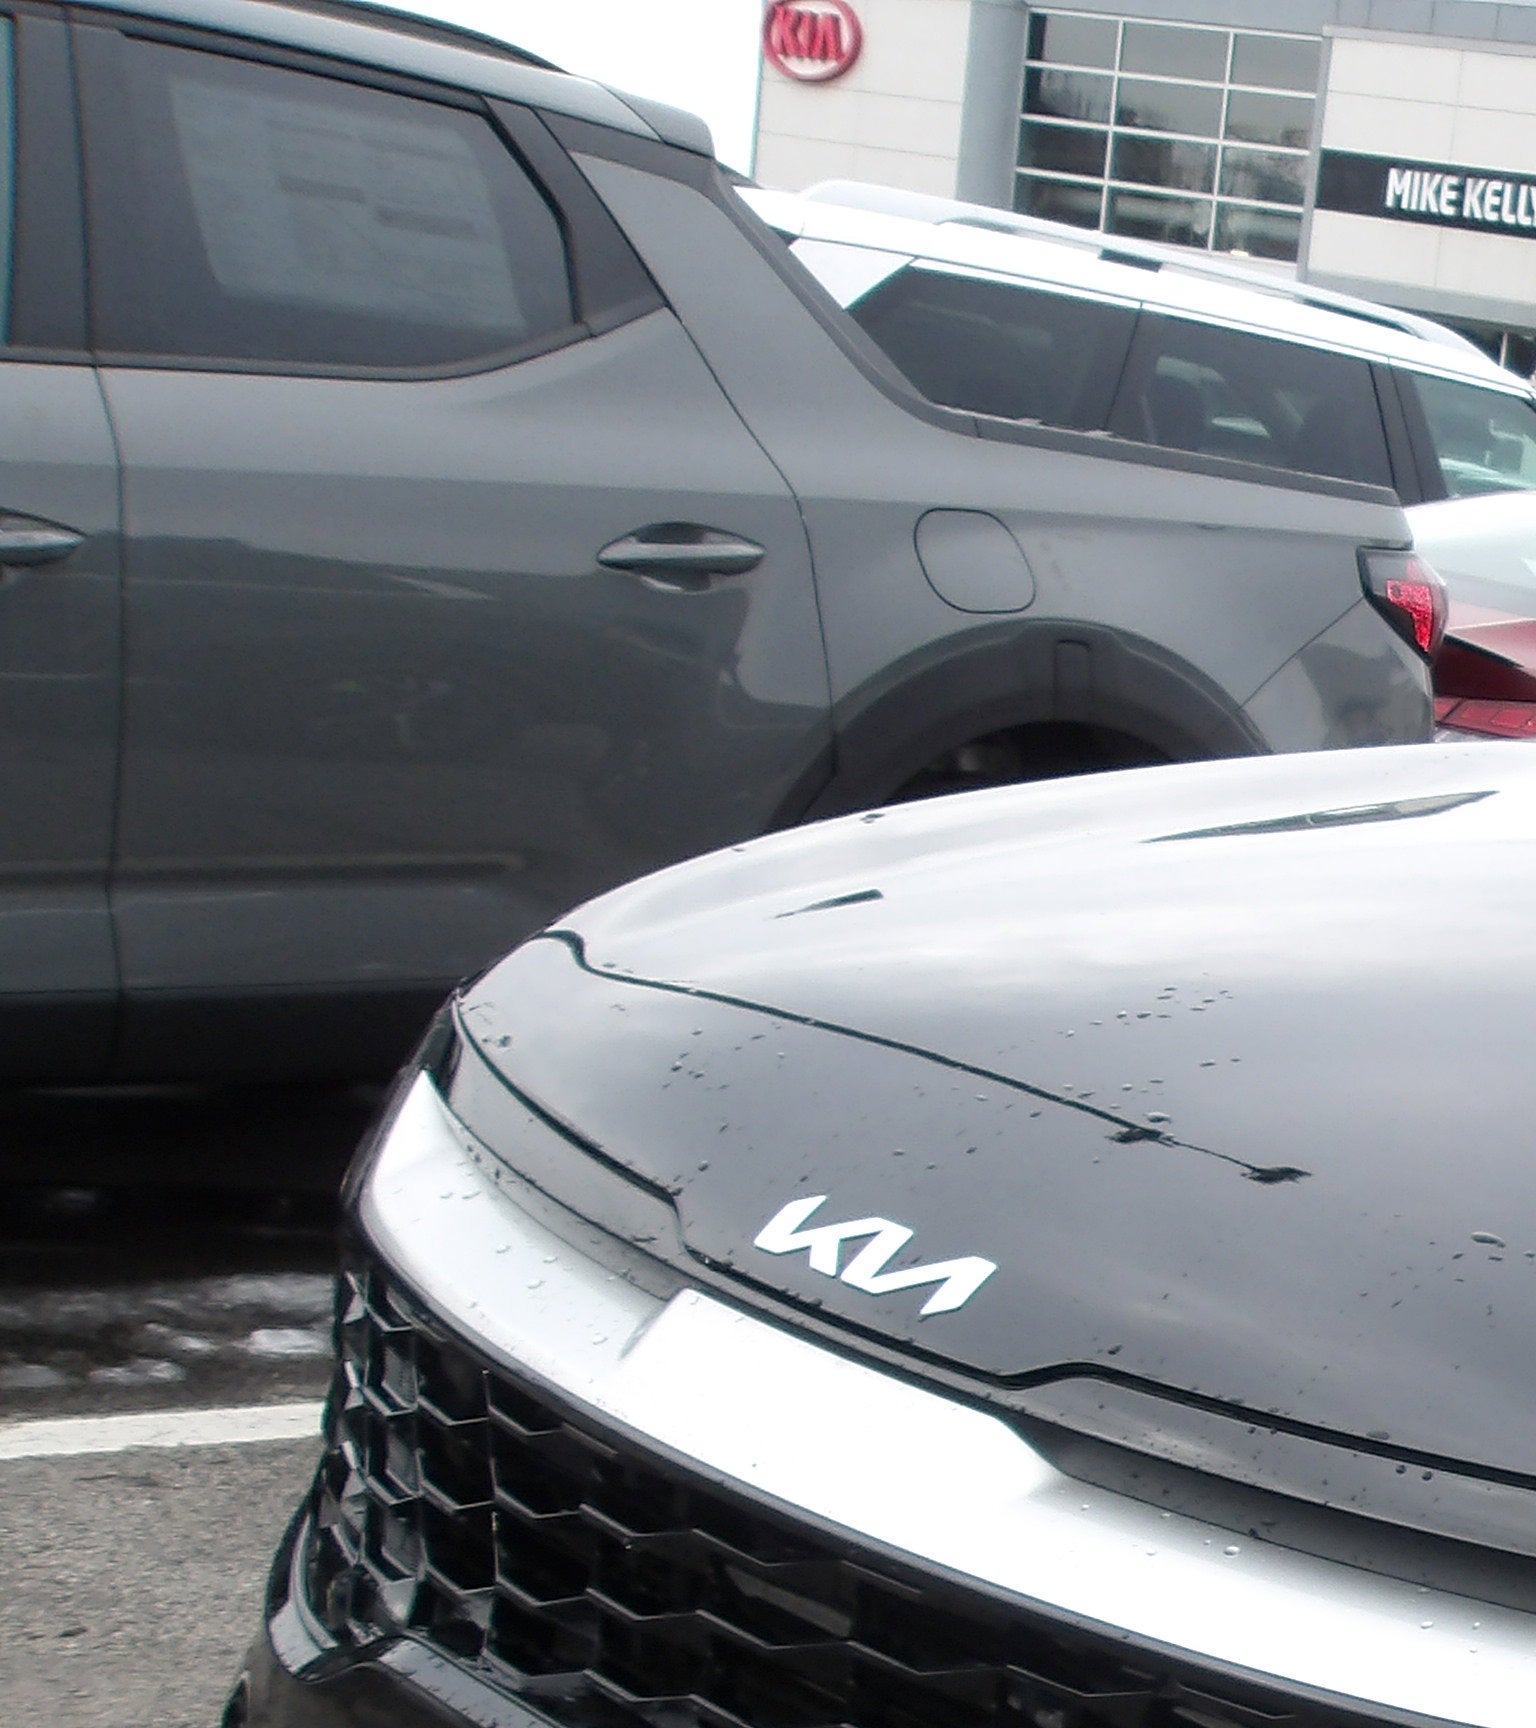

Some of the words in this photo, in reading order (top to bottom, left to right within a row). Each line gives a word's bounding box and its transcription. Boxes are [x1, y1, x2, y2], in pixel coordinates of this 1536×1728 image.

[771, 5, 845, 63] KIA
[1385, 168, 1459, 216] MIKE
[754, 1195, 998, 1317] KIA
